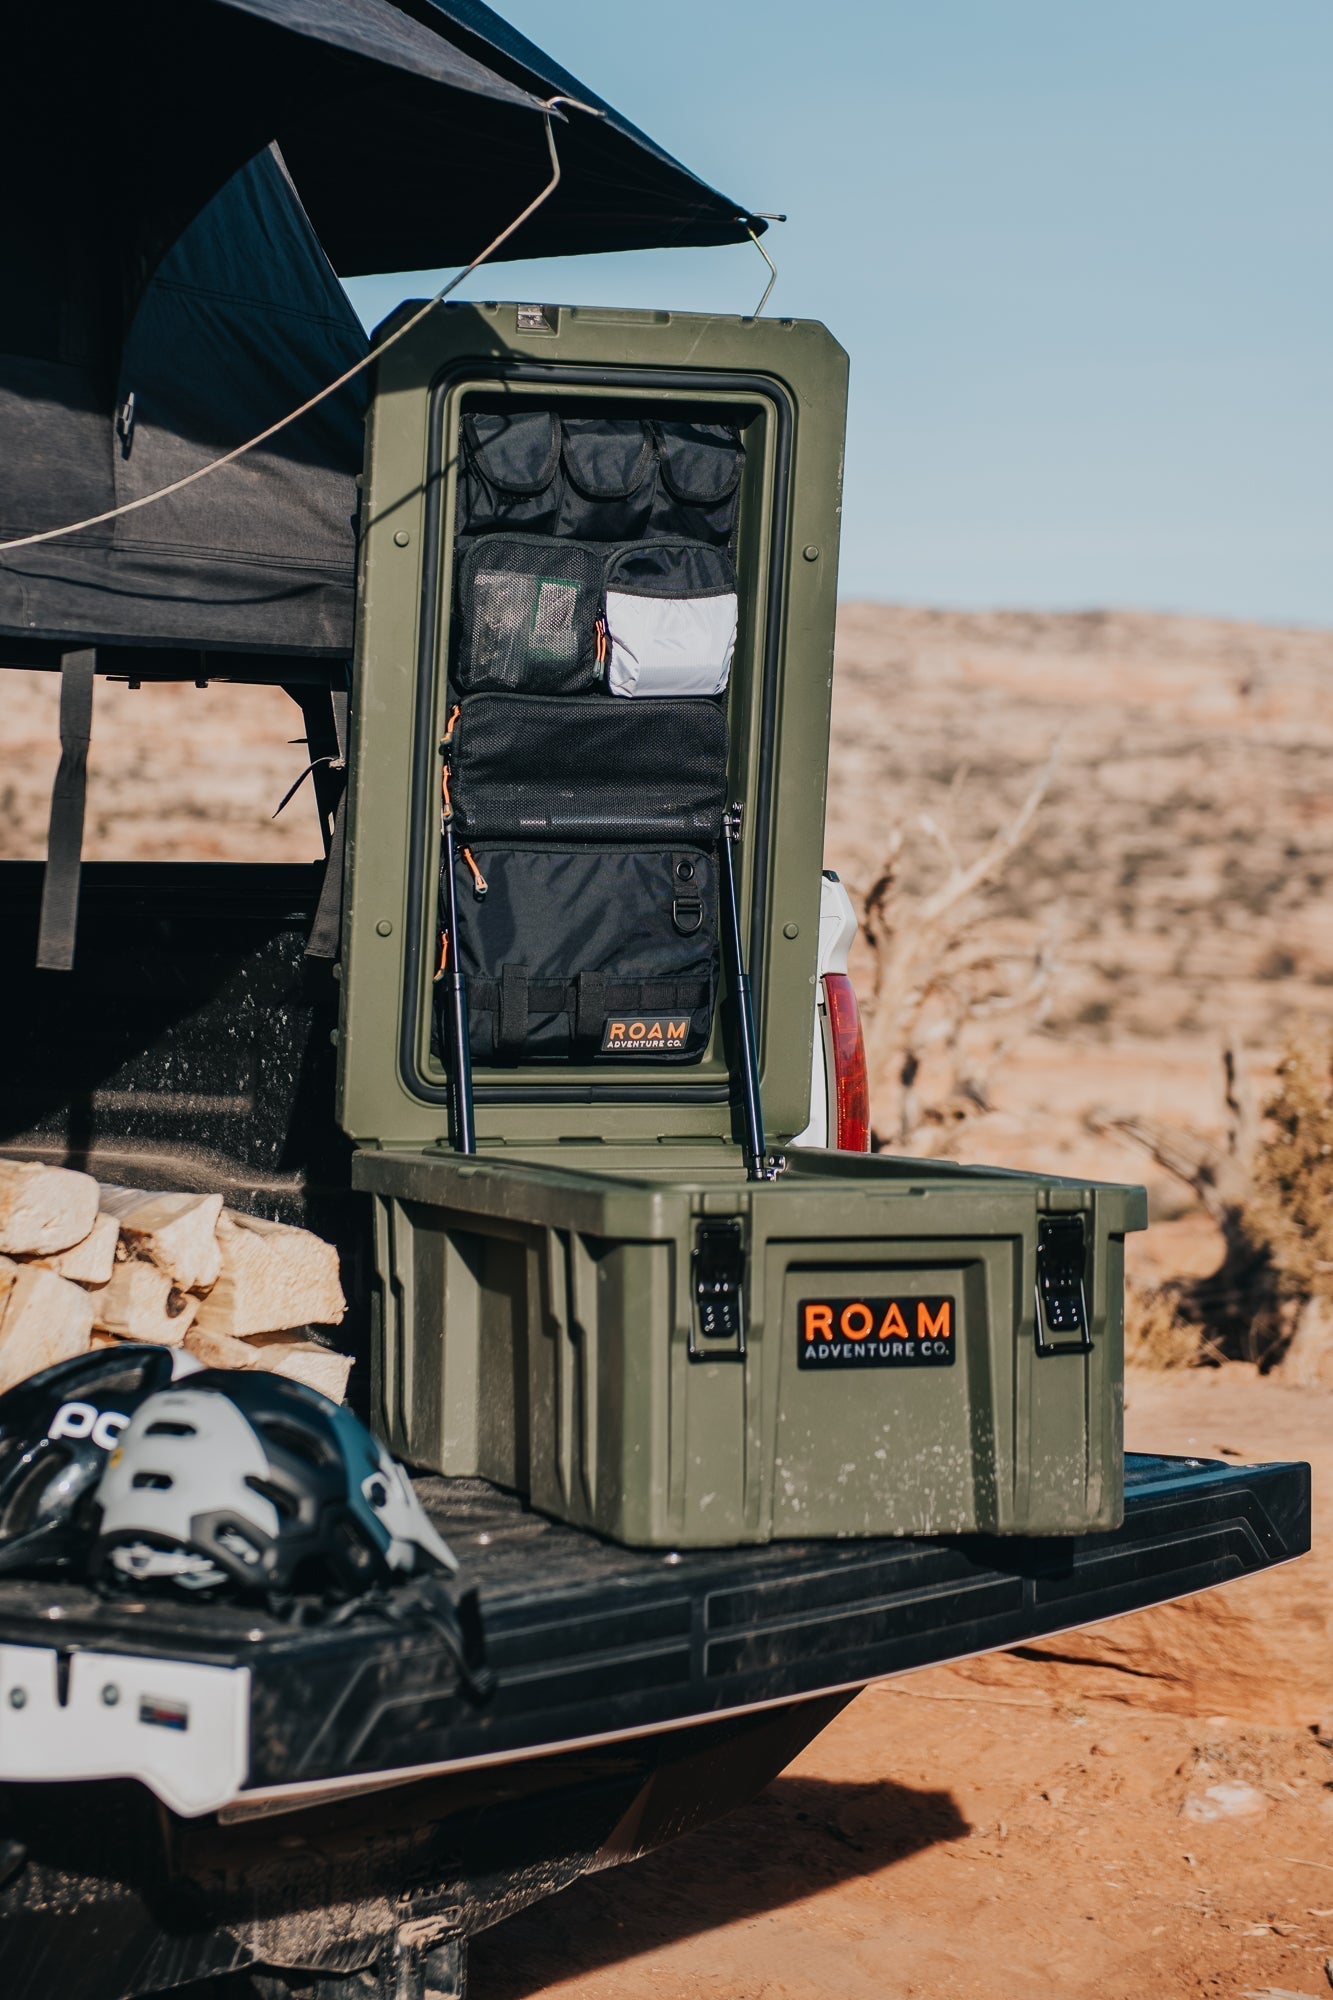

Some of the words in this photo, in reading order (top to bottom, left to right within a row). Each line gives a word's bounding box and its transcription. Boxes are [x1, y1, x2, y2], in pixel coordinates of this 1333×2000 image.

[609, 1022, 687, 1040] ROAM
[606, 1040, 665, 1048] ADVENTURE
[804, 1301, 951, 1341] ROAM
[804, 1342, 915, 1359] ADVENTURE
[920, 1341, 950, 1356] CO.
